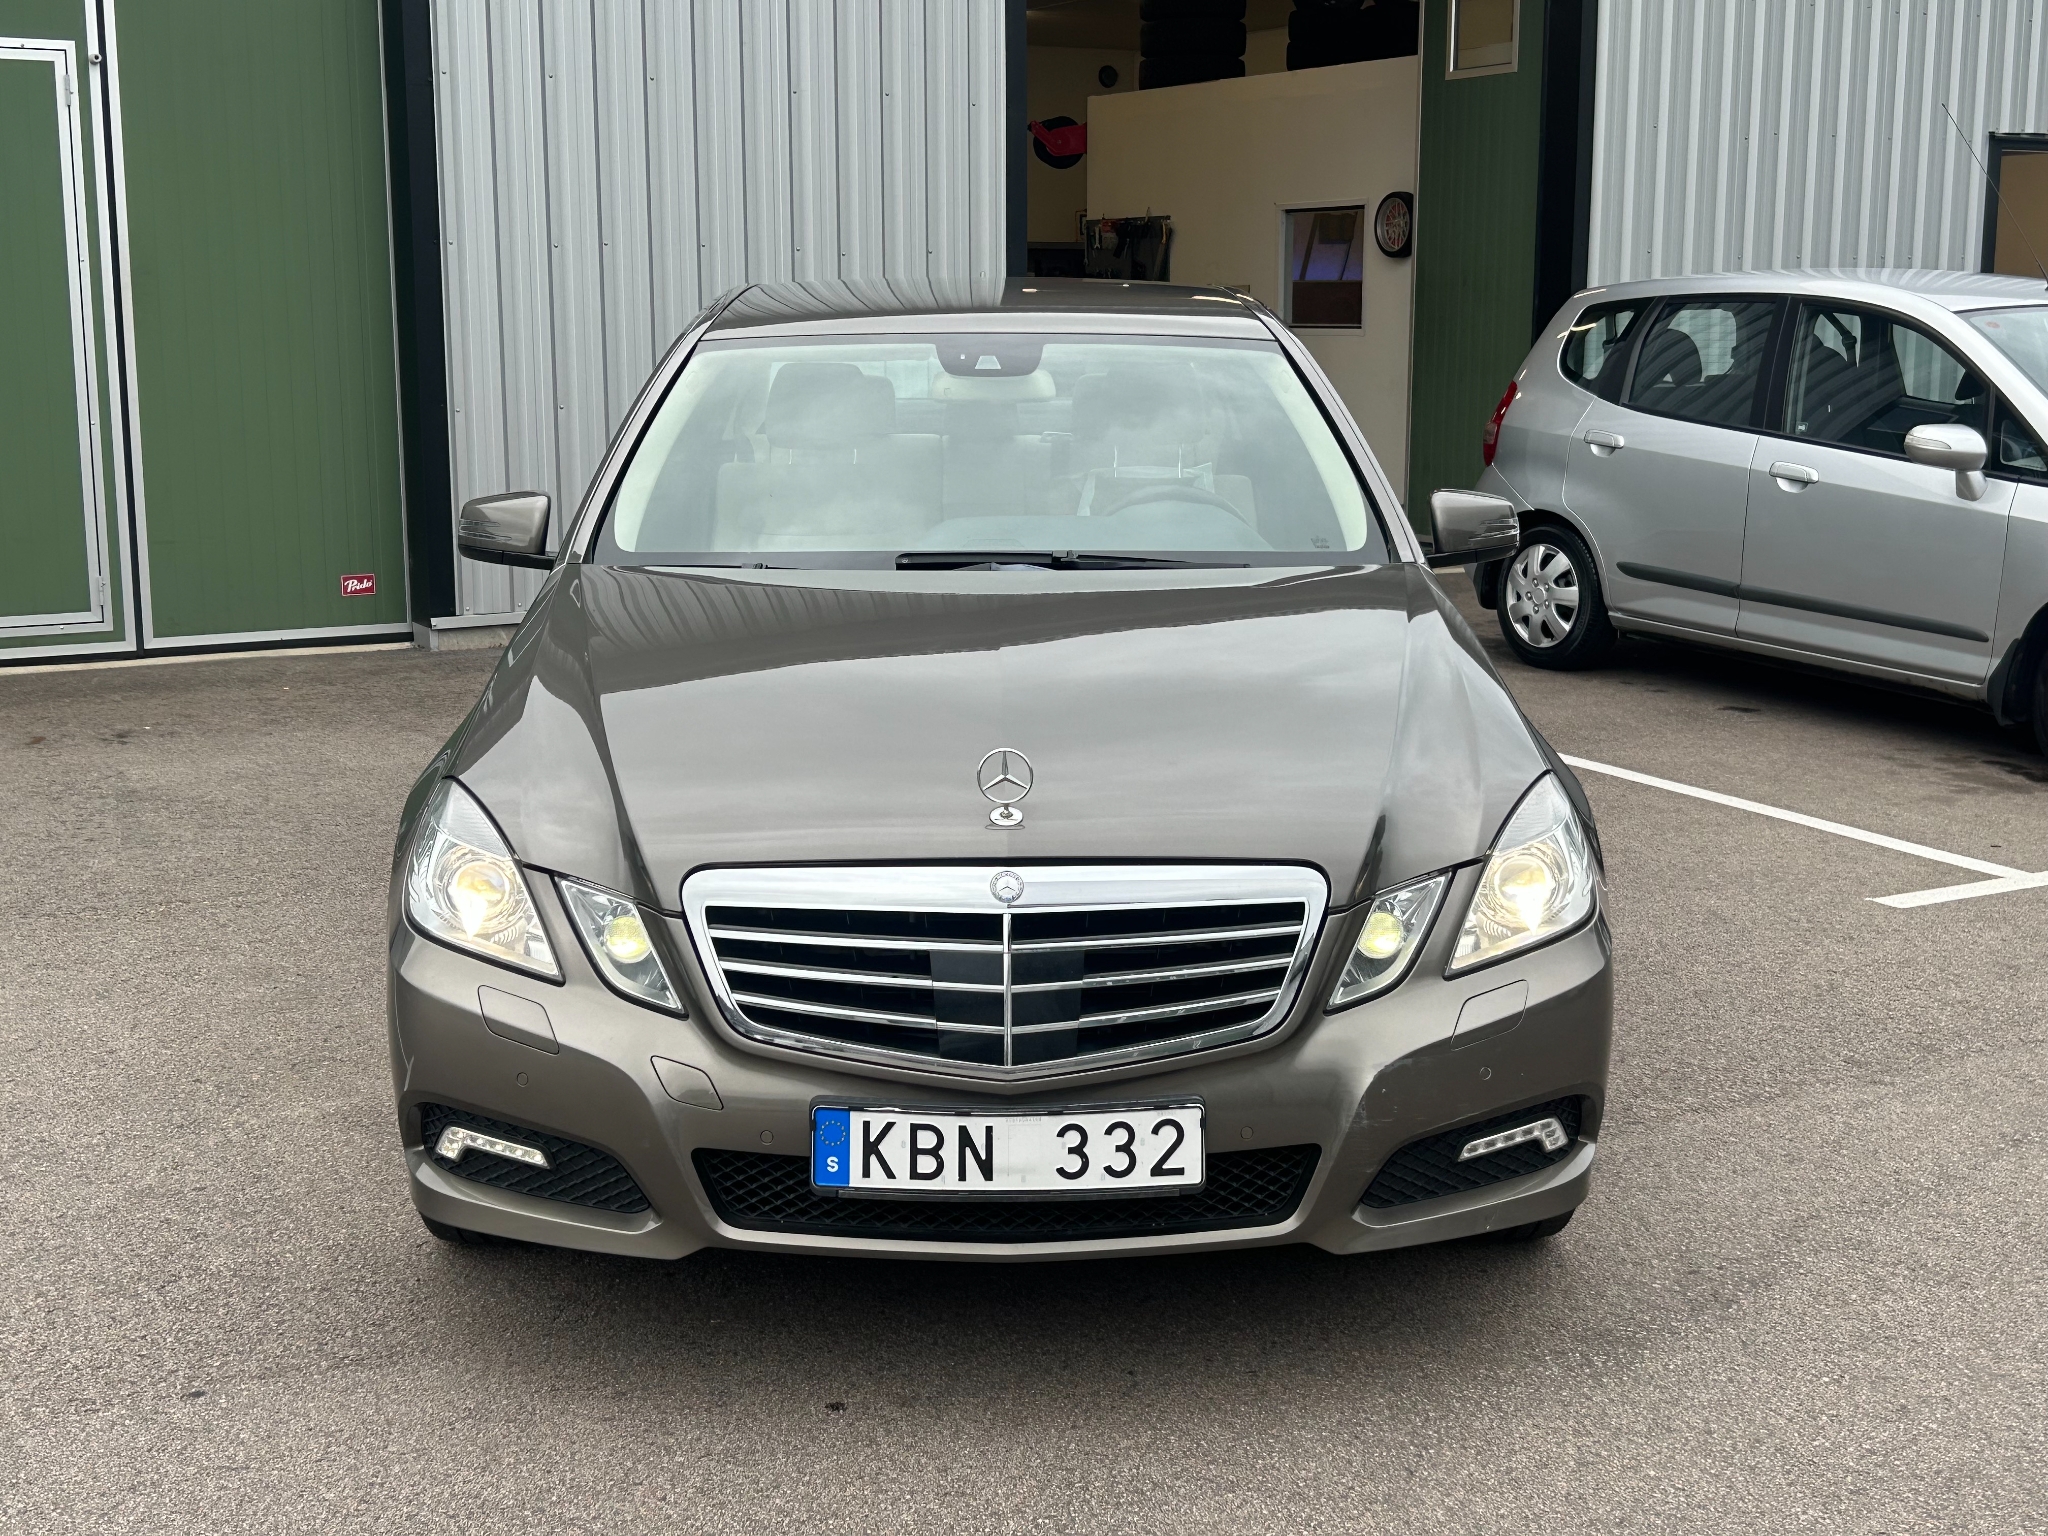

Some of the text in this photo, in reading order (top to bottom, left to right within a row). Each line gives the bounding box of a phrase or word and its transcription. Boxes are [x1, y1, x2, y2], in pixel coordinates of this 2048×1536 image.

[344, 578, 373, 593] Prido
[861, 1118, 1186, 1182] KBN 332
[826, 1156, 839, 1173] S
